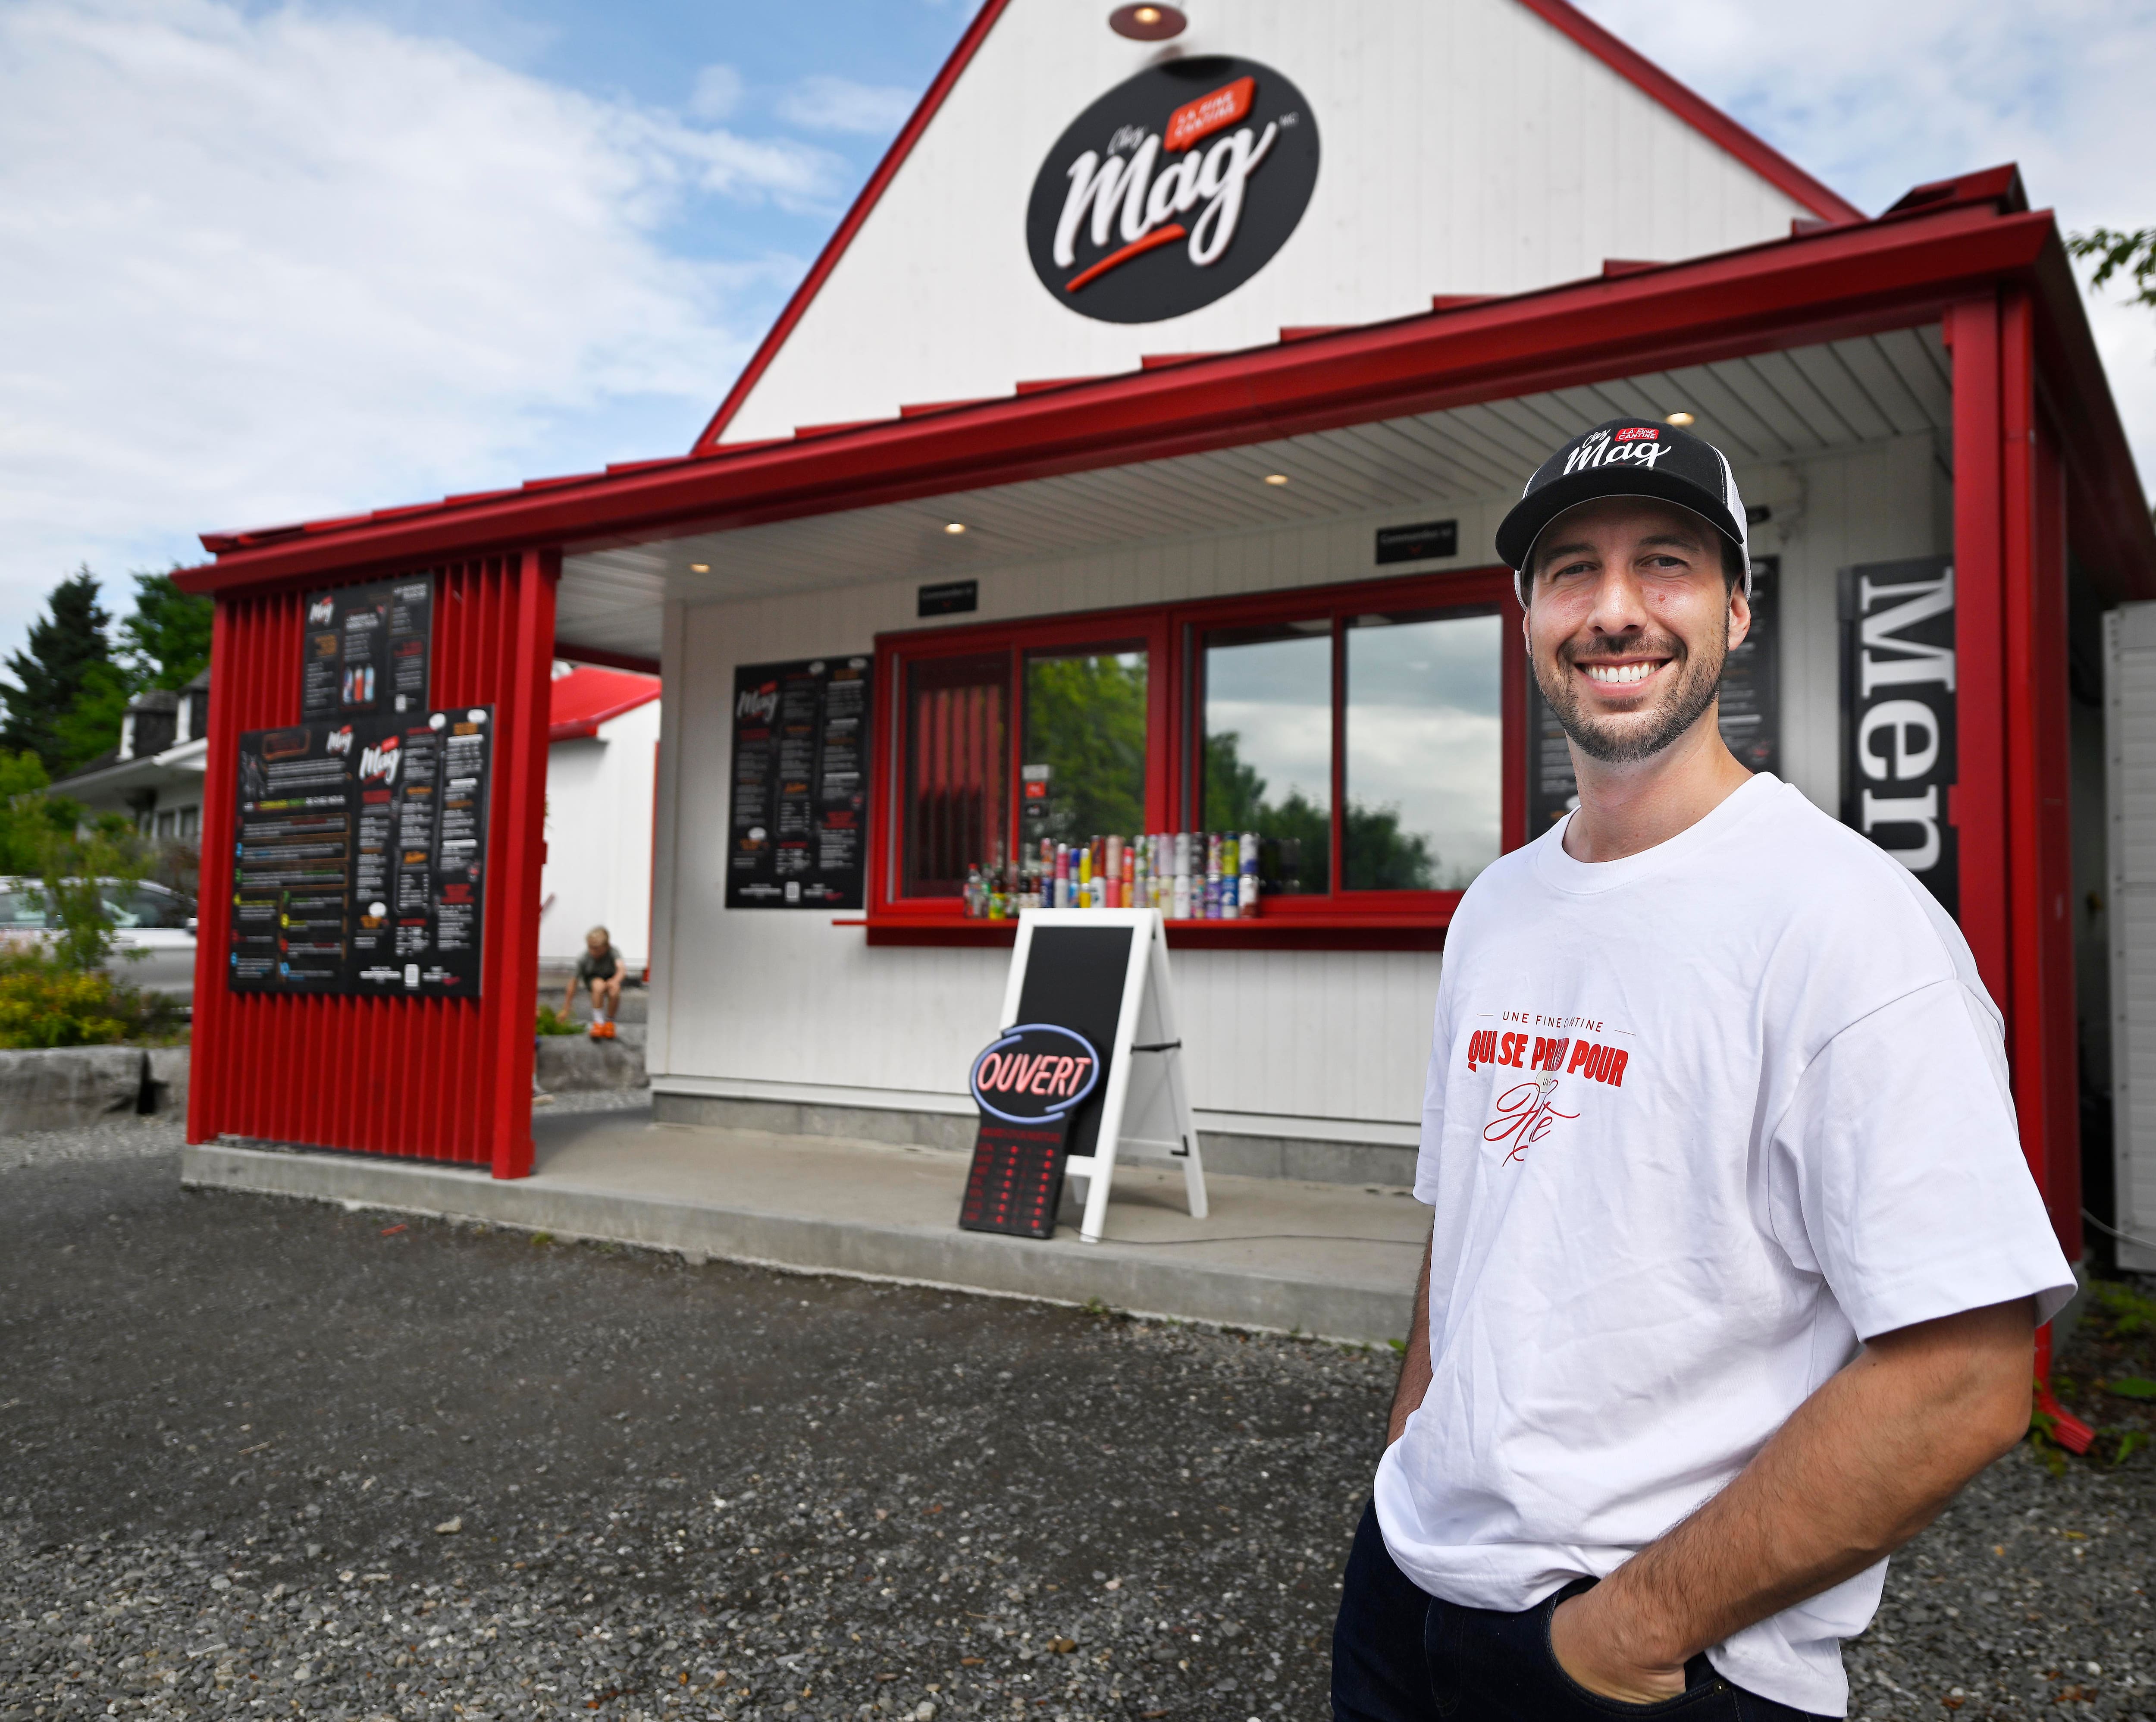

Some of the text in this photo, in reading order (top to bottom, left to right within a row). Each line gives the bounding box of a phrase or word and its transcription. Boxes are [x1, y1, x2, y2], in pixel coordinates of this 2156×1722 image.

[1053, 121, 1277, 268] Mag
[1562, 436, 1672, 476] Mag
[1582, 429, 1611, 449] Chez
[359, 746, 401, 785] Mag
[1503, 1011, 1603, 1032] UNE FINE CNTINE
[977, 1053, 1092, 1097] OUVERT
[1468, 1030, 1498, 1073] QUI
[1498, 1032, 1529, 1068] SE
[1567, 1039, 1629, 1087] POUR
